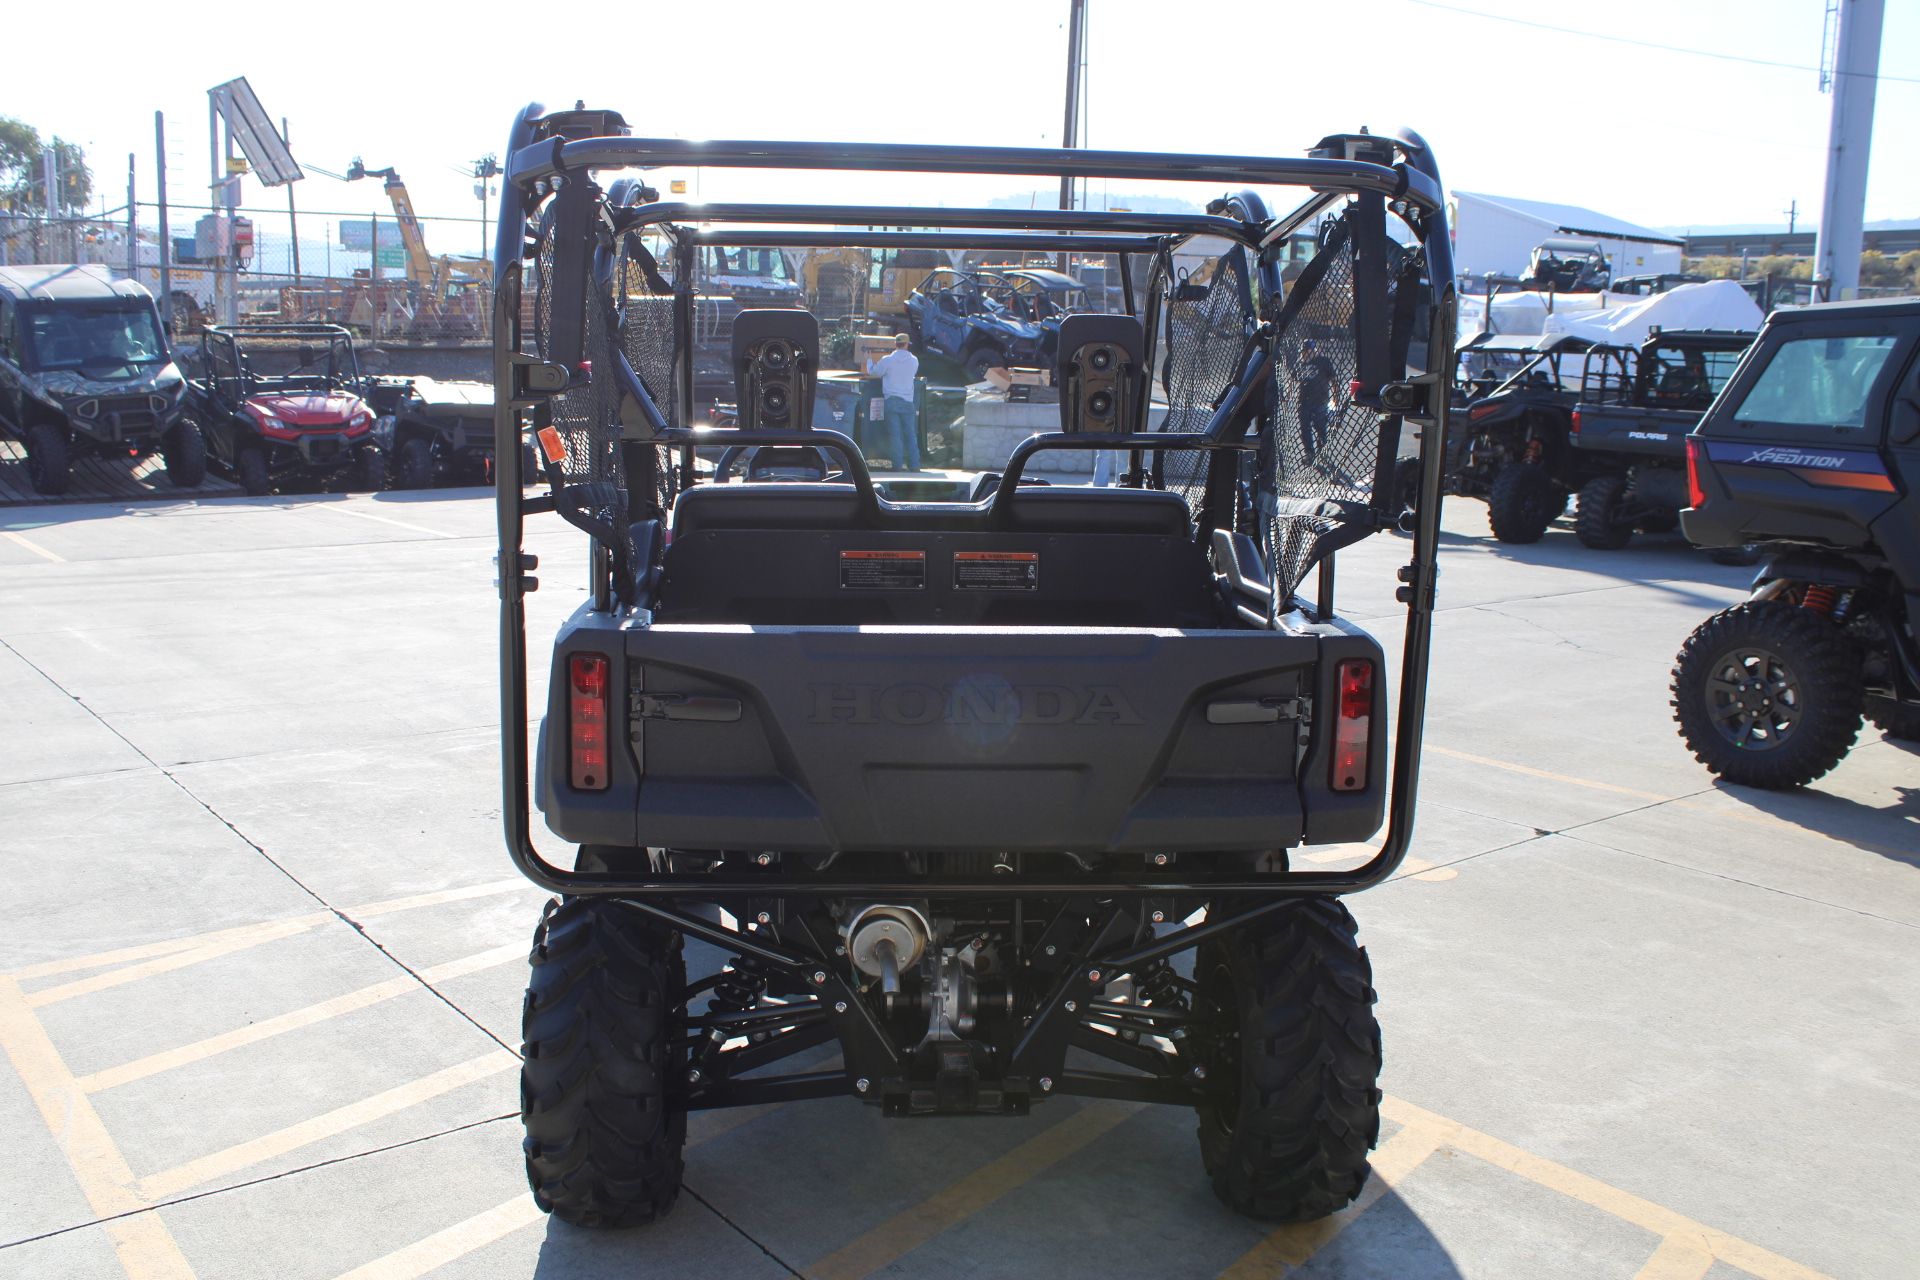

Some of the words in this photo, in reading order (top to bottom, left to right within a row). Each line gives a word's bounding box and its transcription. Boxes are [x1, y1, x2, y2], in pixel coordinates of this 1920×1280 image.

[1628, 431, 1668, 441] POLARIS
[1742, 448, 1845, 468] XPEDITION
[807, 682, 1146, 726] HONDA
